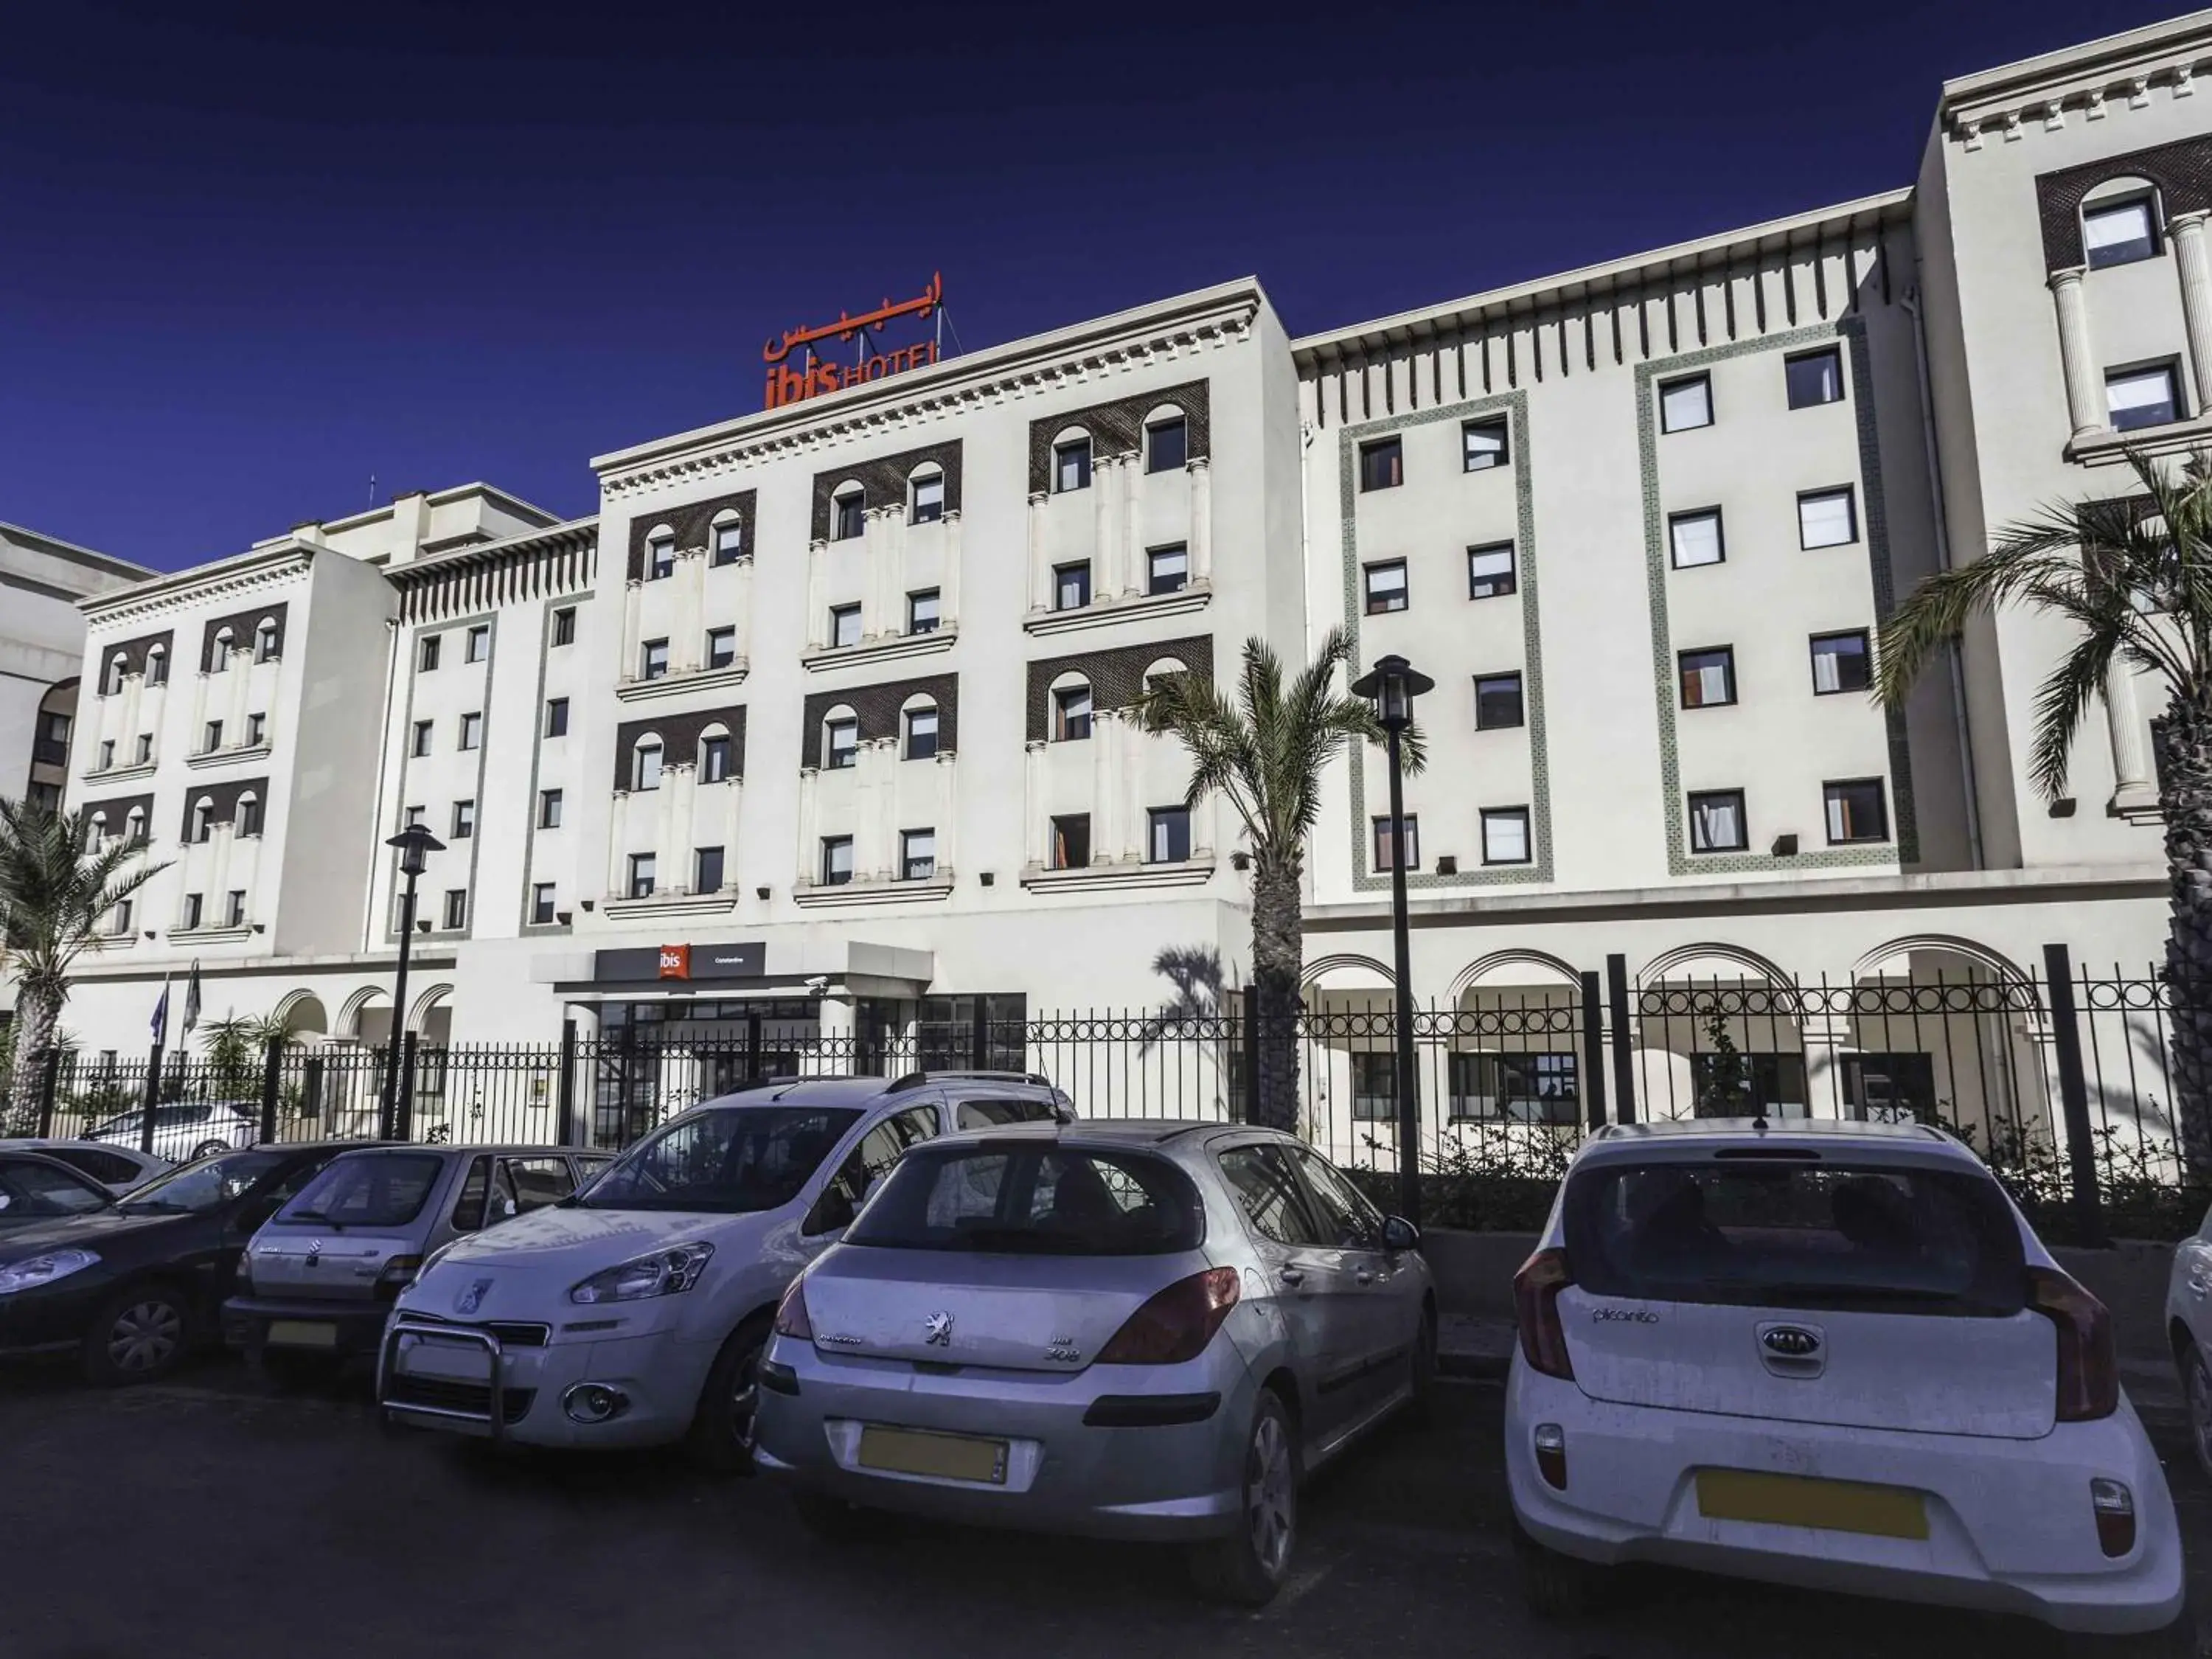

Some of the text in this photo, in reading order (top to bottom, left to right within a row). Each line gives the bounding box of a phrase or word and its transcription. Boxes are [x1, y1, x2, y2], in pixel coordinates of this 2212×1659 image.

[765, 356, 838, 410] ibis
[660, 952, 681, 968] ibis
[1043, 1346, 1081, 1363] 308
